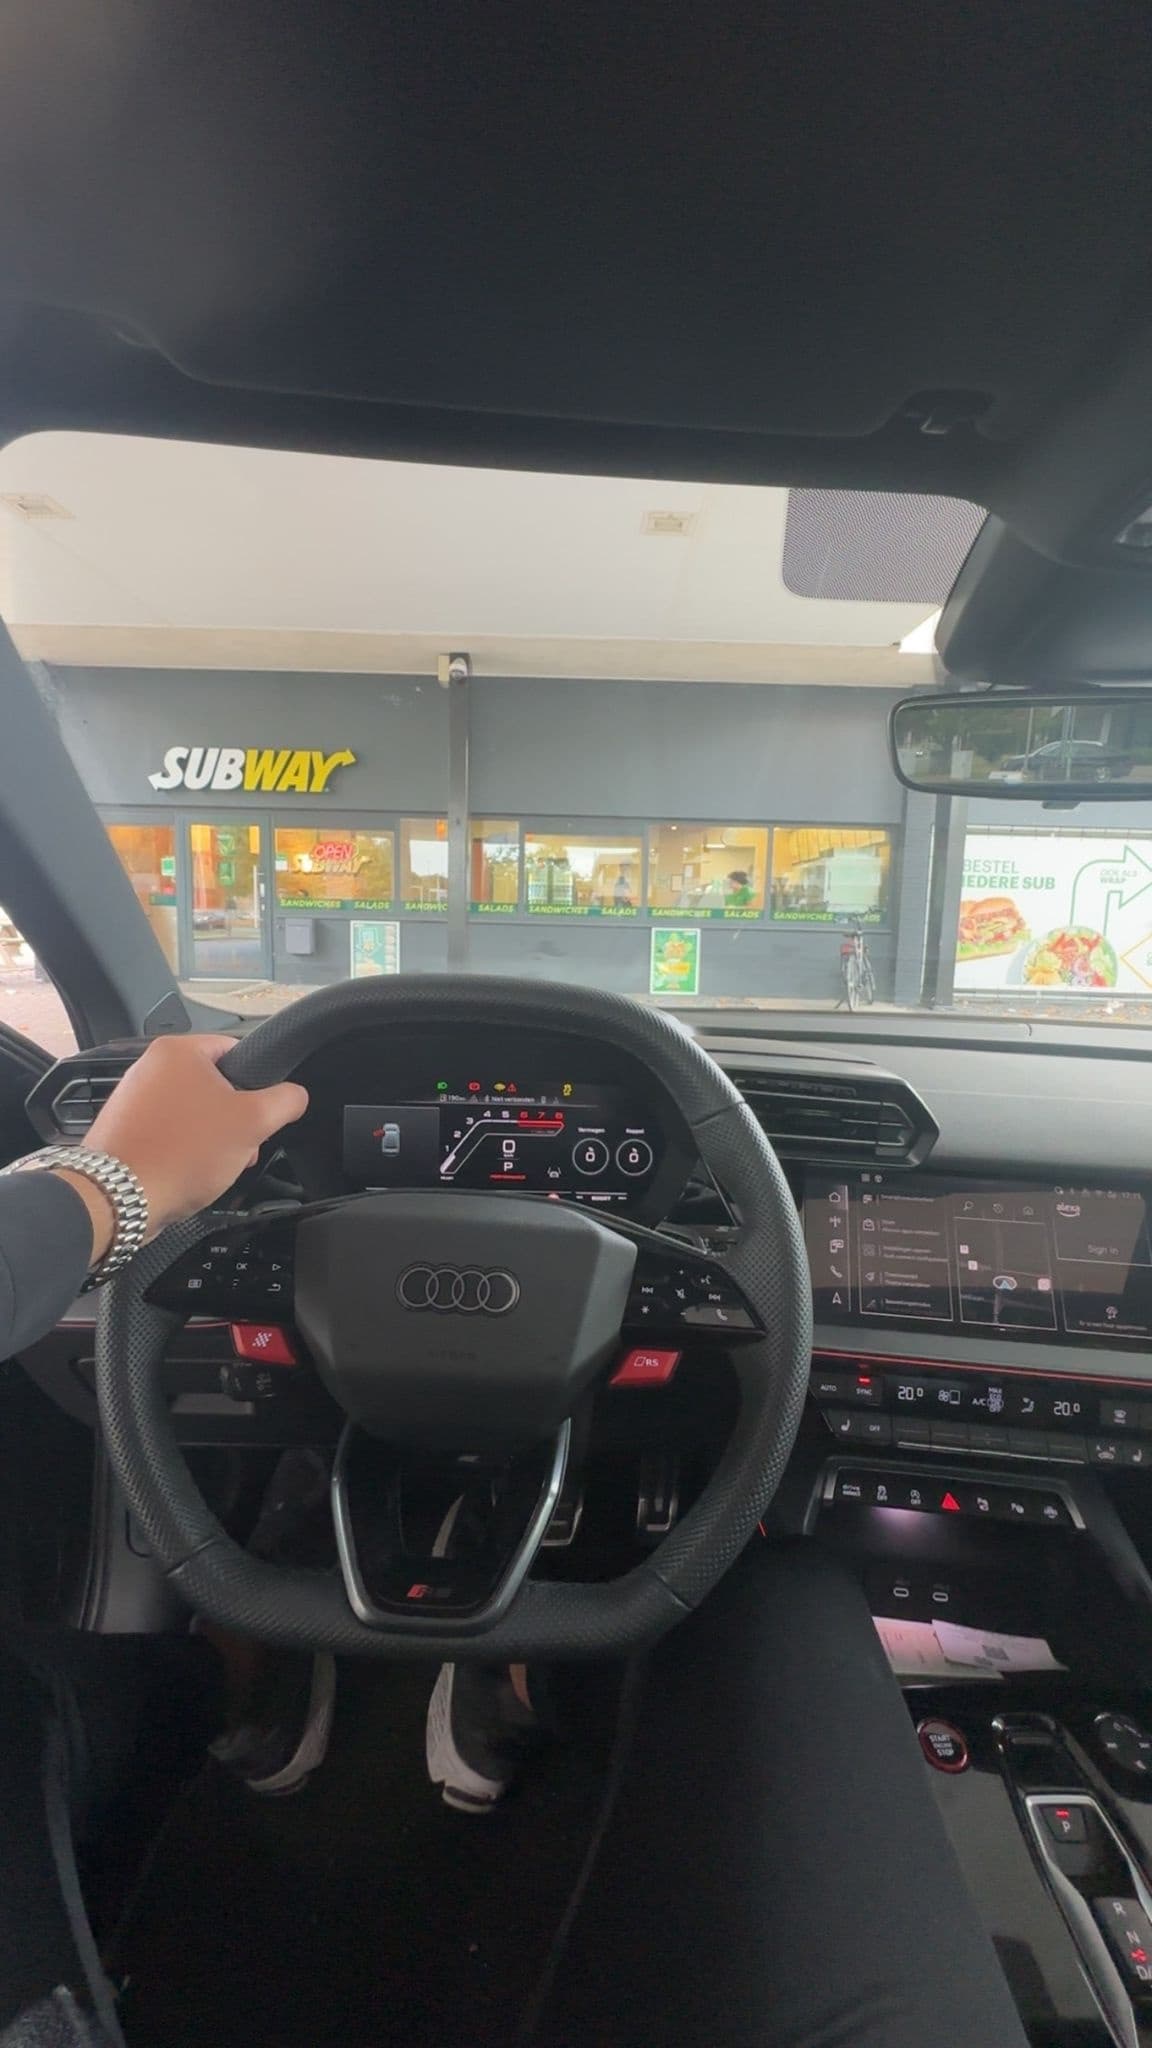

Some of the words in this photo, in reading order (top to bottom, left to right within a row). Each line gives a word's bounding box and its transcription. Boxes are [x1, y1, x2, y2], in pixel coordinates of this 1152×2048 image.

[148, 747, 357, 792] SUBWAY
[314, 842, 353, 860] OPEN
[963, 859, 1019, 874] BESTEL
[1022, 876, 1056, 890] SUB
[280, 899, 341, 909] SANDWICHES
[354, 900, 390, 910] SALADS
[404, 902, 448, 912] SANDWIC
[478, 903, 515, 914] SALADS
[529, 906, 589, 915] SANDWICHES
[601, 908, 638, 917] SALADS
[652, 909, 712, 918] SANDWICHES
[724, 911, 760, 919] SALADS
[773, 911, 833, 921] SANDWICHES
[501, 1110, 510, 1118] 5
[465, 1117, 474, 1125] 3
[453, 1130, 462, 1138] 2
[502, 1139, 516, 1154] 0
[503, 1161, 514, 1172] P
[1056, 1202, 1081, 1212] alexa
[236, 1262, 248, 1270] OK
[645, 1358, 659, 1366] RS
[820, 1383, 838, 1392] AUTO
[855, 1387, 873, 1396] SYNC
[929, 1734, 951, 1742] START
[937, 1748, 954, 1757] STOP
[1062, 1820, 1071, 1833] P
[1112, 1902, 1127, 1916] R
[1125, 1930, 1141, 1944] N
